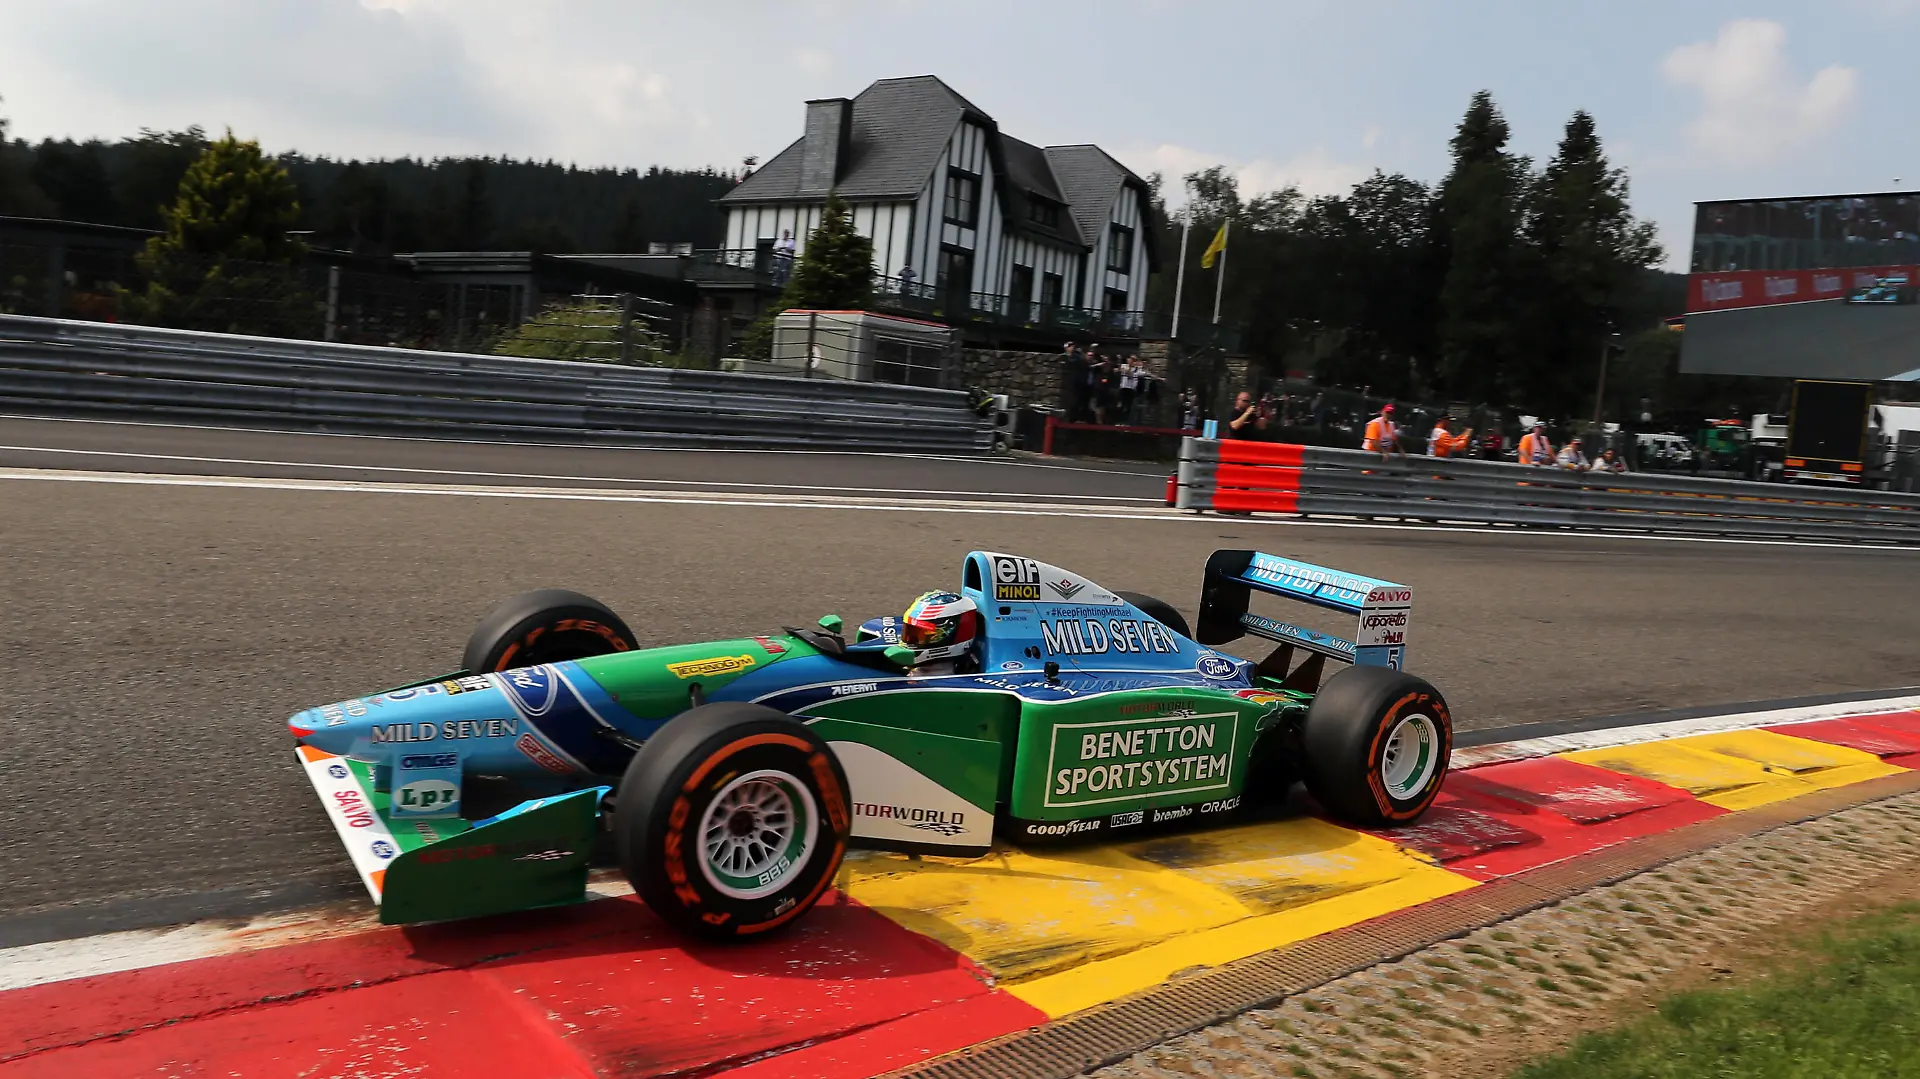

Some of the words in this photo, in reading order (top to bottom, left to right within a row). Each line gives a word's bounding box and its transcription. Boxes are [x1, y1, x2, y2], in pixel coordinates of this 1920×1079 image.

[996, 558, 1038, 583] elf
[1250, 557, 1377, 603] MOTORWOR
[998, 585, 1040, 599] MINOL
[1367, 591, 1412, 603] SANYO
[1050, 607, 1132, 618] #KeepFightingMichael
[1243, 613, 1269, 628] MILD
[1268, 619, 1301, 637] SEVEN
[1040, 619, 1109, 657] MILD
[1108, 618, 1180, 654] SEVEN
[1204, 658, 1232, 676] Ford
[371, 723, 439, 744] MILD
[441, 718, 519, 741] SEVEN
[1080, 723, 1217, 761] BENETTON
[1055, 752, 1228, 797] SPORTSYSTEM
[333, 790, 376, 828] SANYO
[400, 788, 455, 808] Lpr
[1200, 795, 1242, 813] ORACLE
[853, 802, 965, 826] TORWORLD
[1153, 807, 1194, 822] brembo
[1026, 819, 1101, 837] GOODYEAR
[758, 855, 792, 887] BBS
